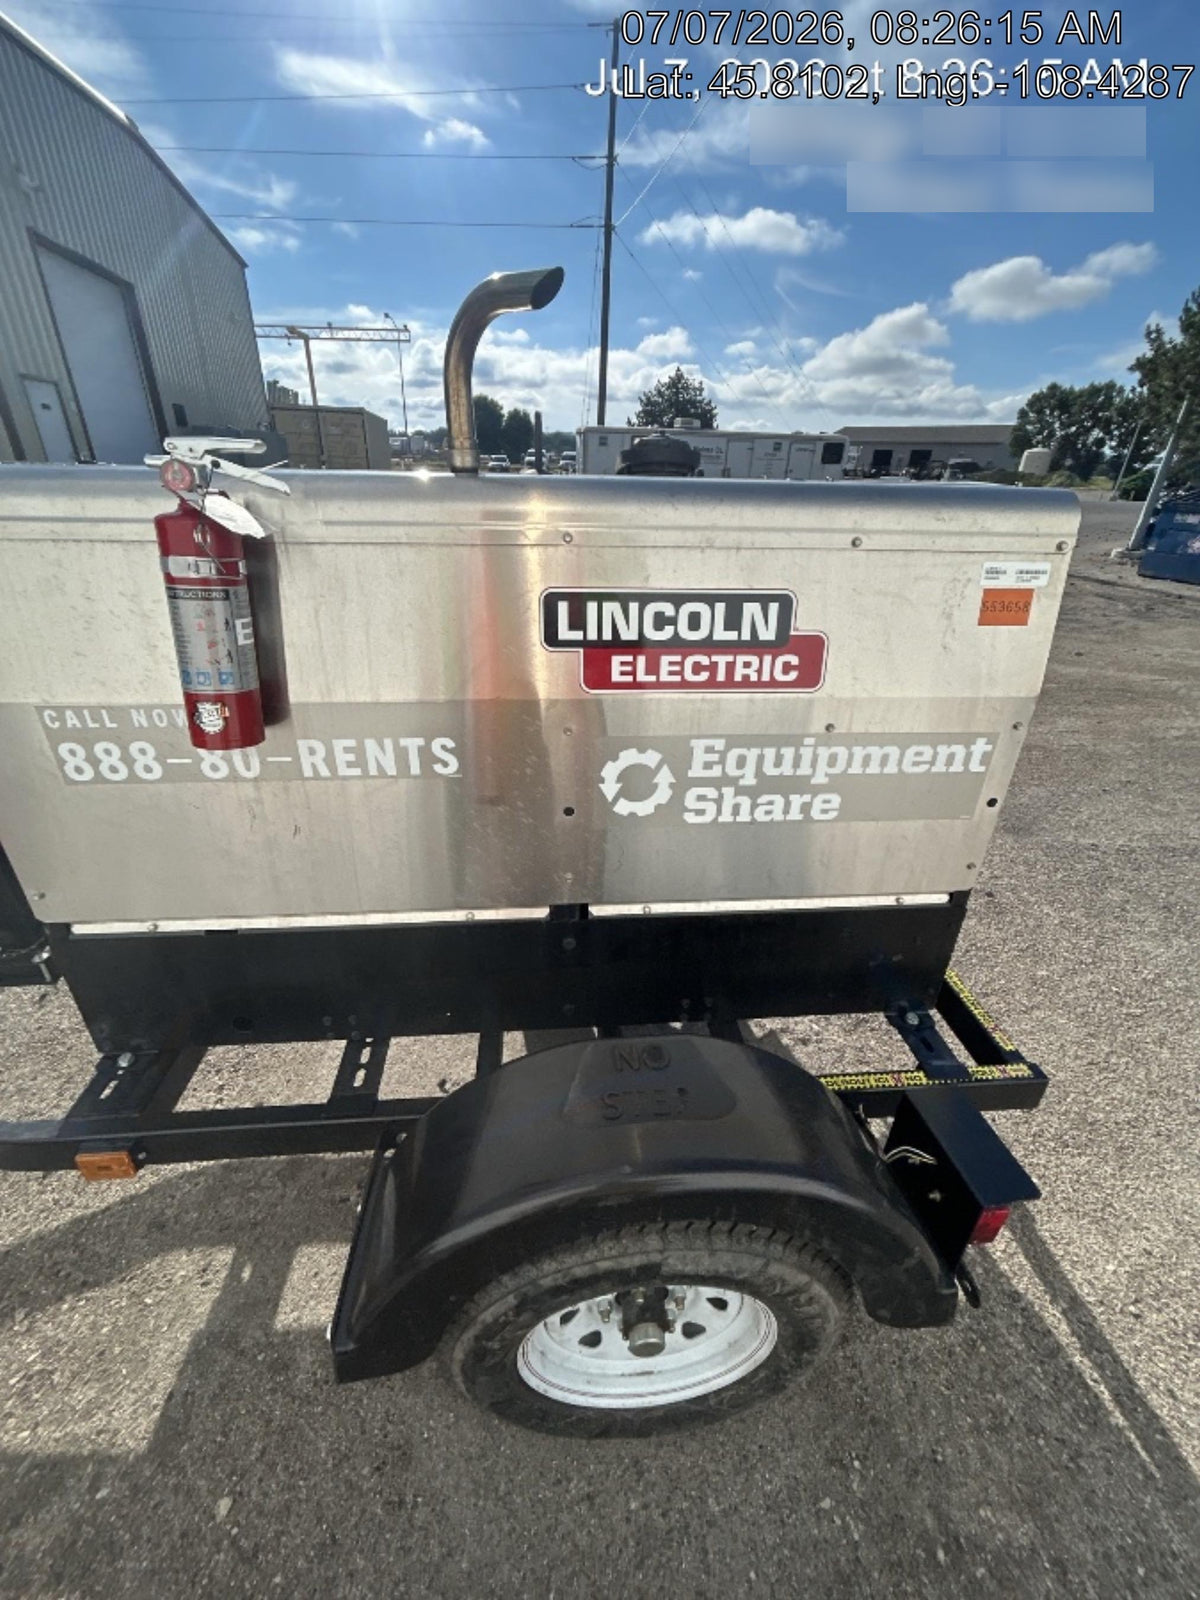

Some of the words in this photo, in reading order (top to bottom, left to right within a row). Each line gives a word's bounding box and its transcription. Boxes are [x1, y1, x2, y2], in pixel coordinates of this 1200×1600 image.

[557, 601, 779, 641] LINCOLN
[611, 654, 799, 683] ELECTRIC
[43, 709, 118, 729] CALL
[688, 737, 992, 785] Equipment
[683, 786, 842, 824] Share
[613, 1045, 671, 1072] NO
